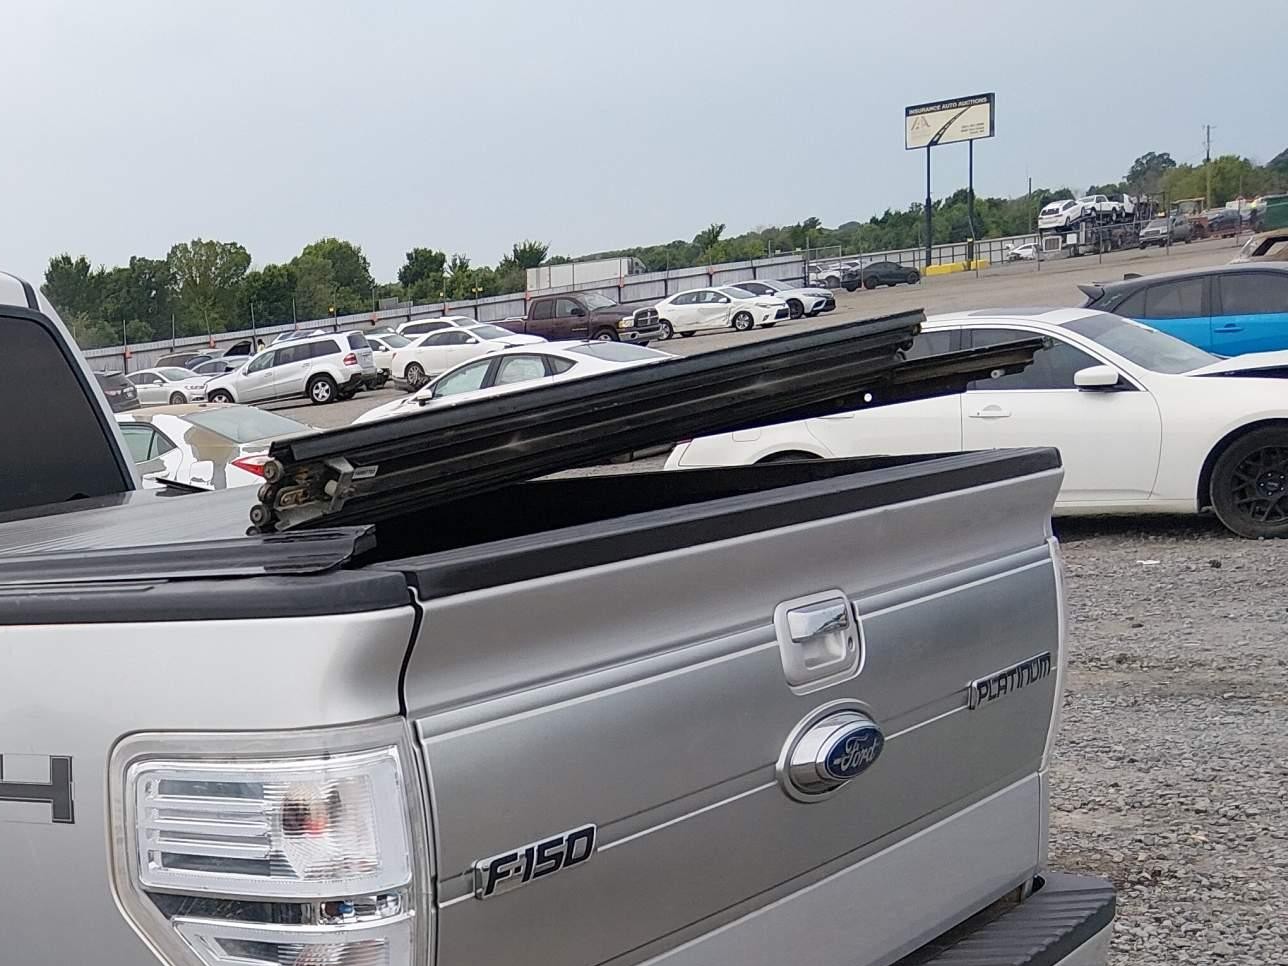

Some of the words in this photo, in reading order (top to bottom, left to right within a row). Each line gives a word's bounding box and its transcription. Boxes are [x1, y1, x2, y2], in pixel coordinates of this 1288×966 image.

[941, 101, 958, 110] AUTO
[976, 652, 1051, 706] PLATINUM
[834, 733, 880, 772] Ford
[481, 825, 597, 898] F-150
